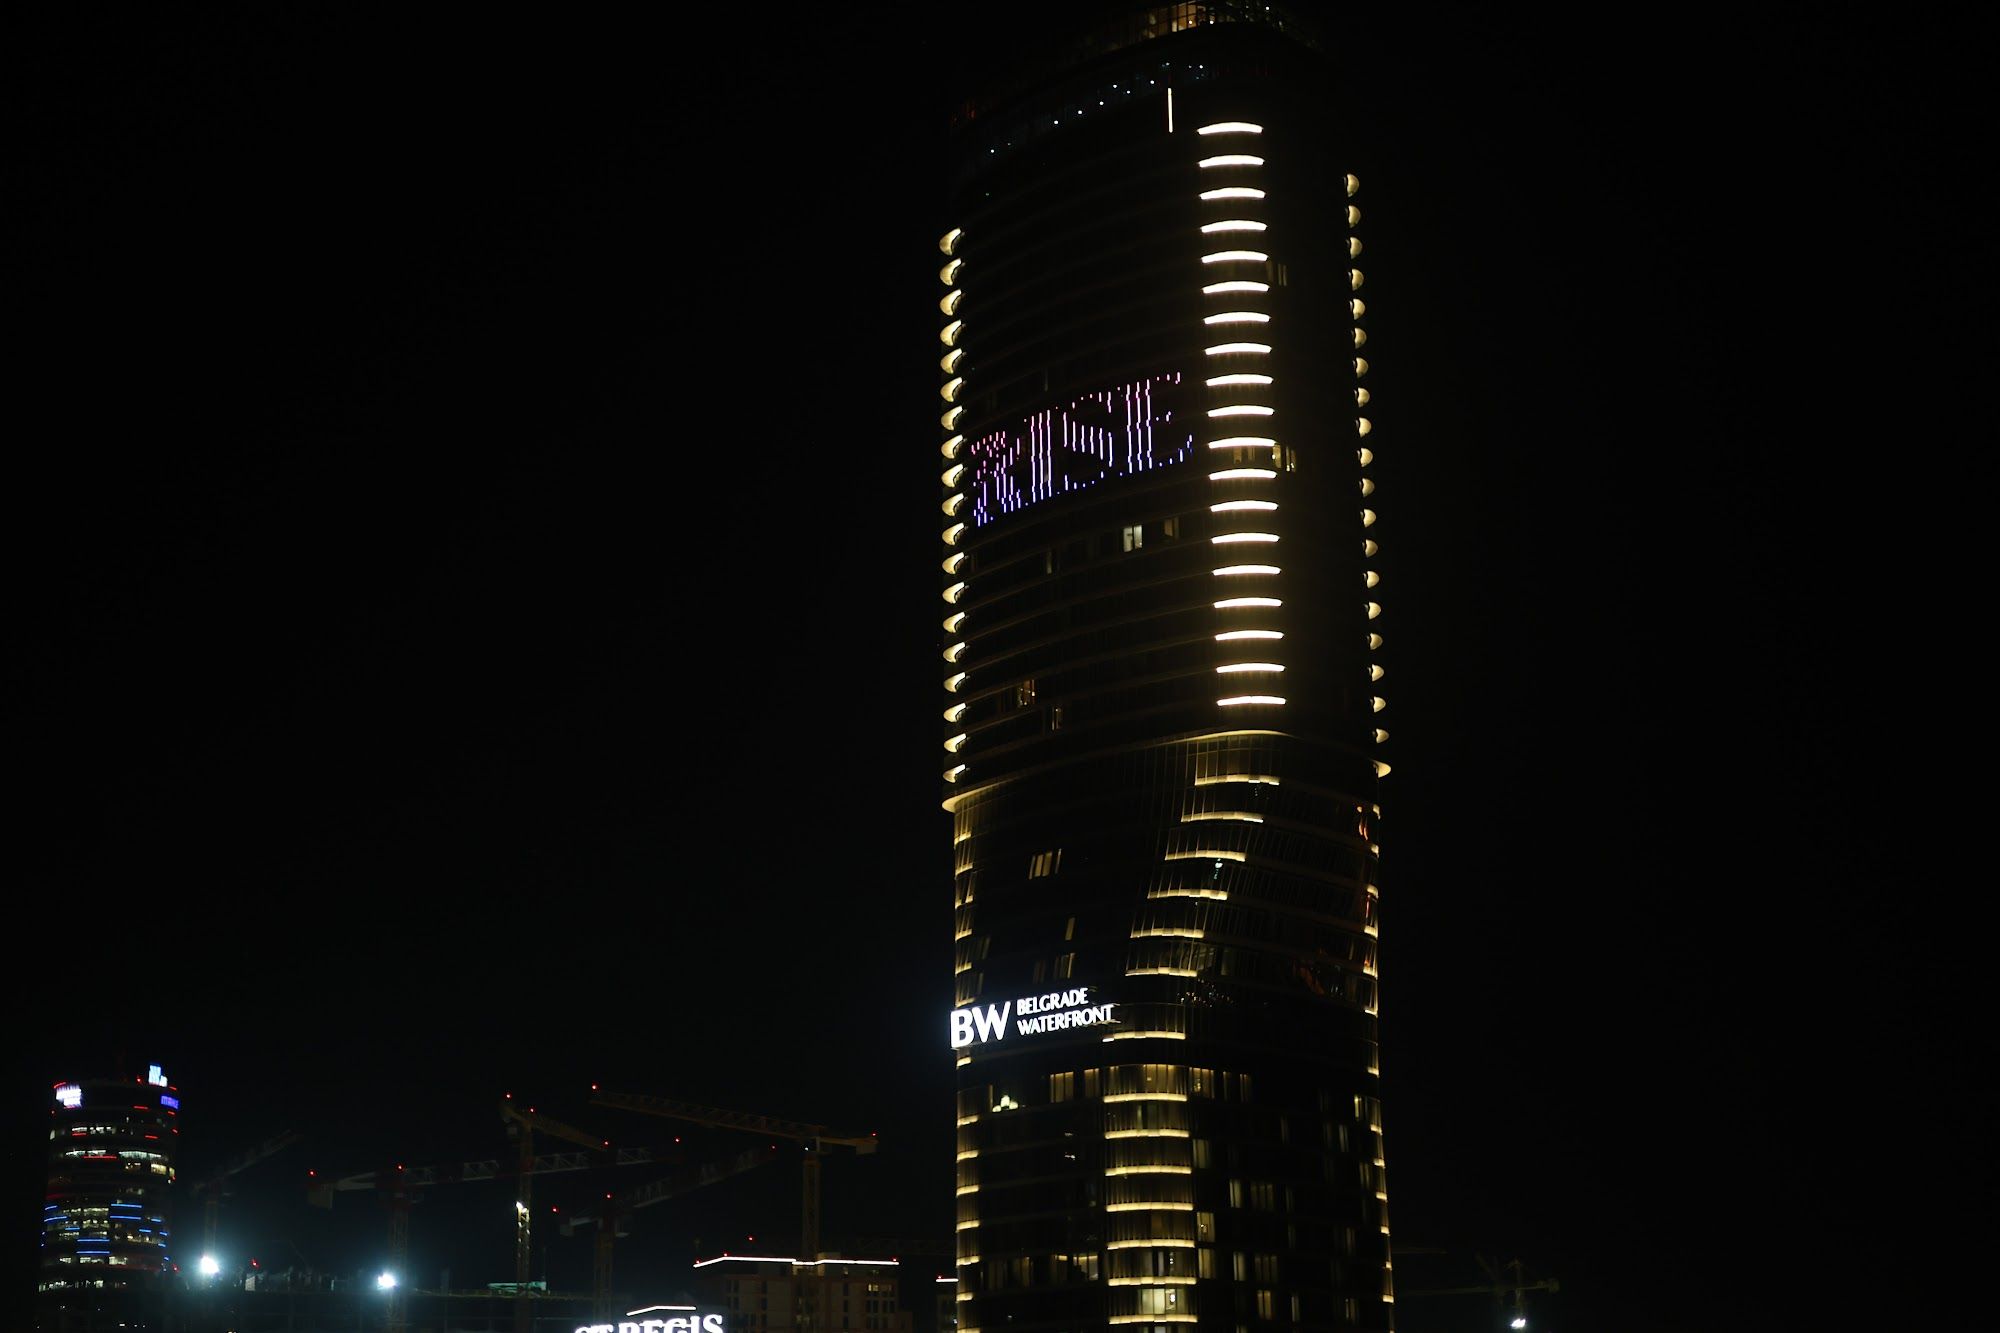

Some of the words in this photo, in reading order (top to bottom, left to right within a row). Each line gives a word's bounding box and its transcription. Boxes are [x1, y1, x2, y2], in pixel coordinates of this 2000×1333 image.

[1016, 987, 1089, 1016] BELGRADE
[950, 1001, 1011, 1049] BW
[1016, 1003, 1115, 1036] WATERFRONT
